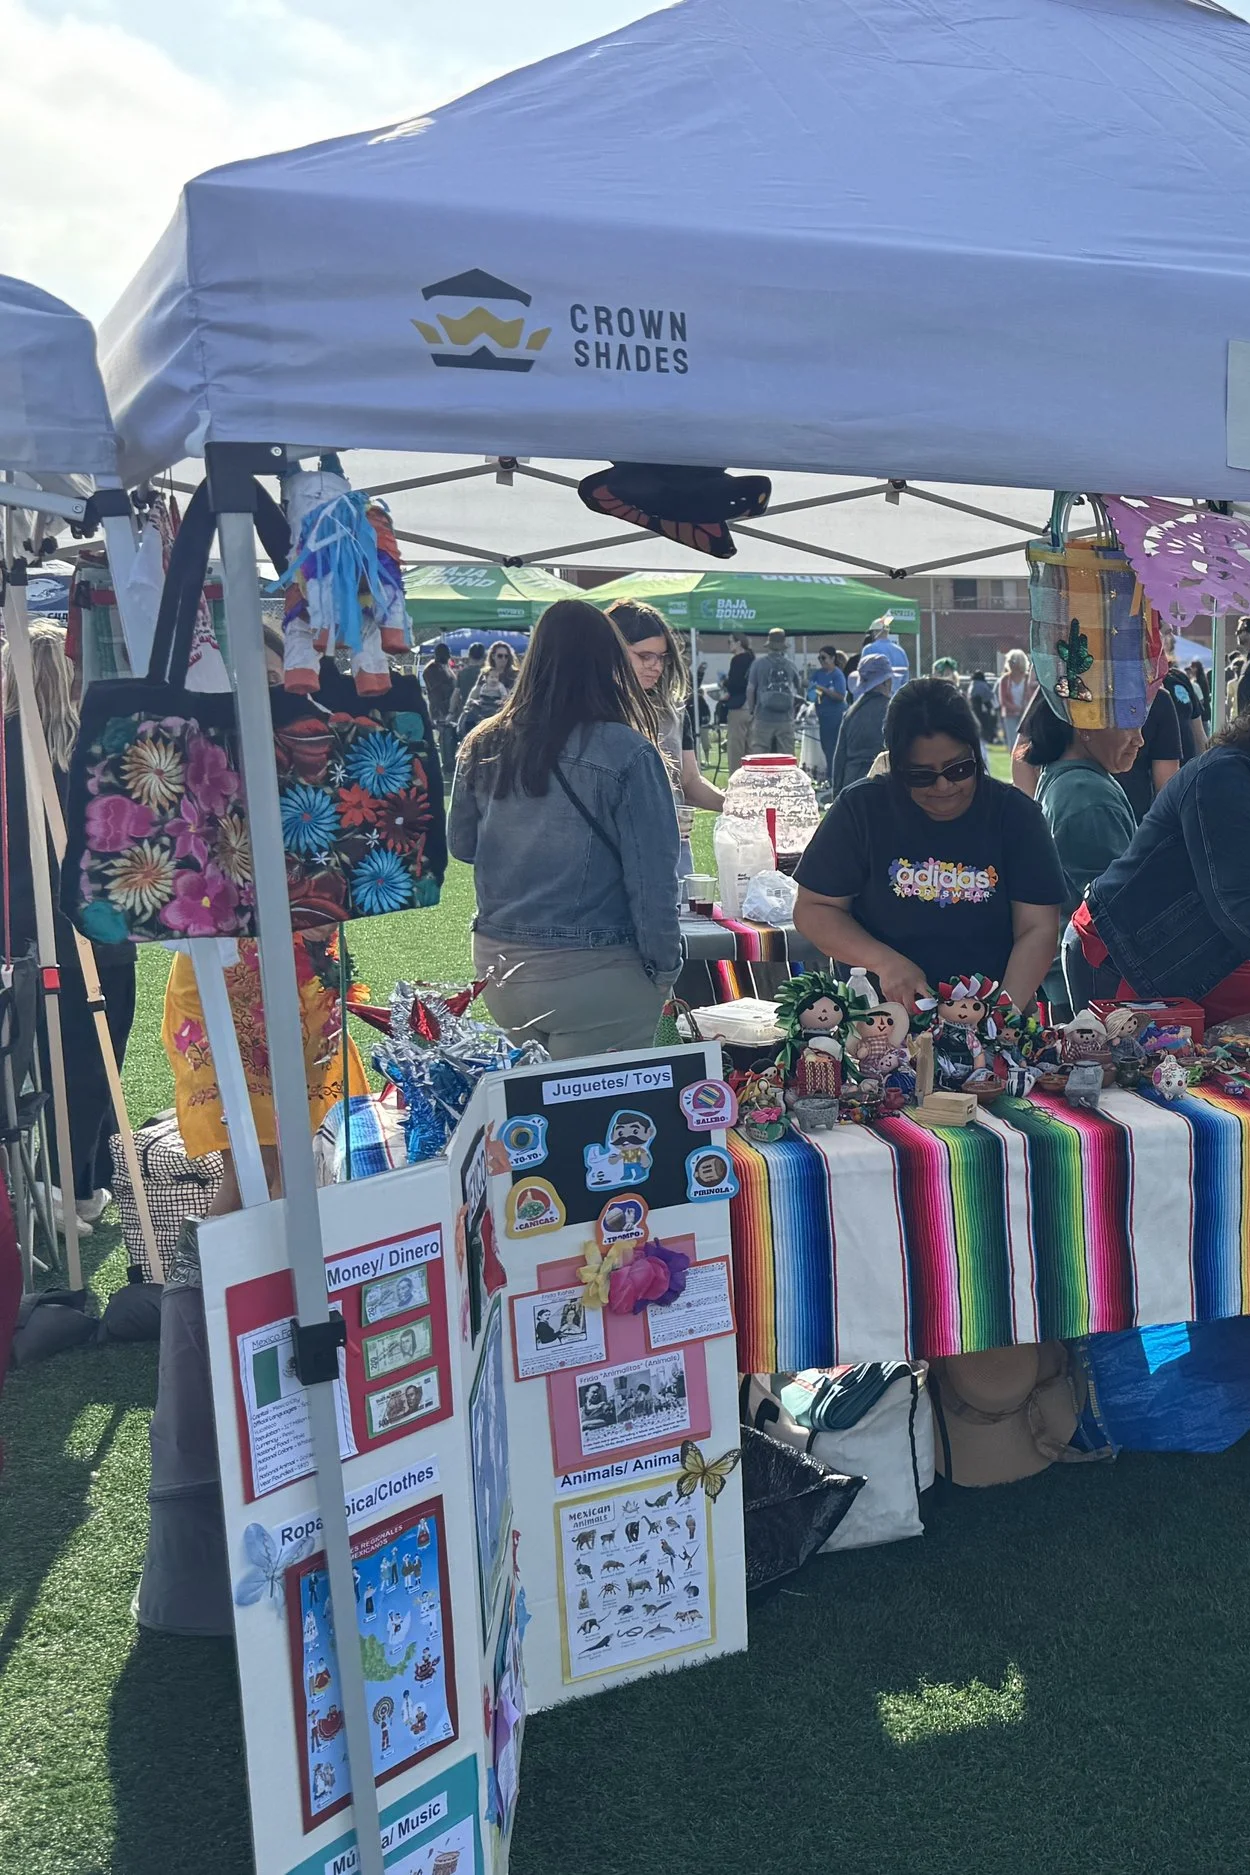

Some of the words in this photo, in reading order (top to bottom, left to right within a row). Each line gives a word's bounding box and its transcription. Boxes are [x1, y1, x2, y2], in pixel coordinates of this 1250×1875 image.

[570, 303, 687, 342] CROWN
[574, 339, 689, 375] SHADES
[715, 609, 756, 619] BOUND
[716, 598, 748, 609] BAJA
[896, 865, 990, 889] adidas
[893, 886, 990, 899] SPORTSWEAR
[551, 1073, 629, 1098] Juguetes/
[632, 1069, 672, 1086] Toys
[693, 1186, 730, 1197] PIRINOLA
[518, 1216, 556, 1231] CANICAS
[326, 1253, 384, 1288] Money/
[389, 1240, 440, 1268] Dinero
[251, 1333, 281, 1349] Mexico
[560, 1462, 629, 1488] Animals/
[632, 1452, 681, 1473] Anima
[568, 1503, 611, 1522] Mexican
[281, 1517, 324, 1546] Ropa
[360, 1525, 404, 1550] REGIONALES
[398, 1802, 441, 1839] Music
